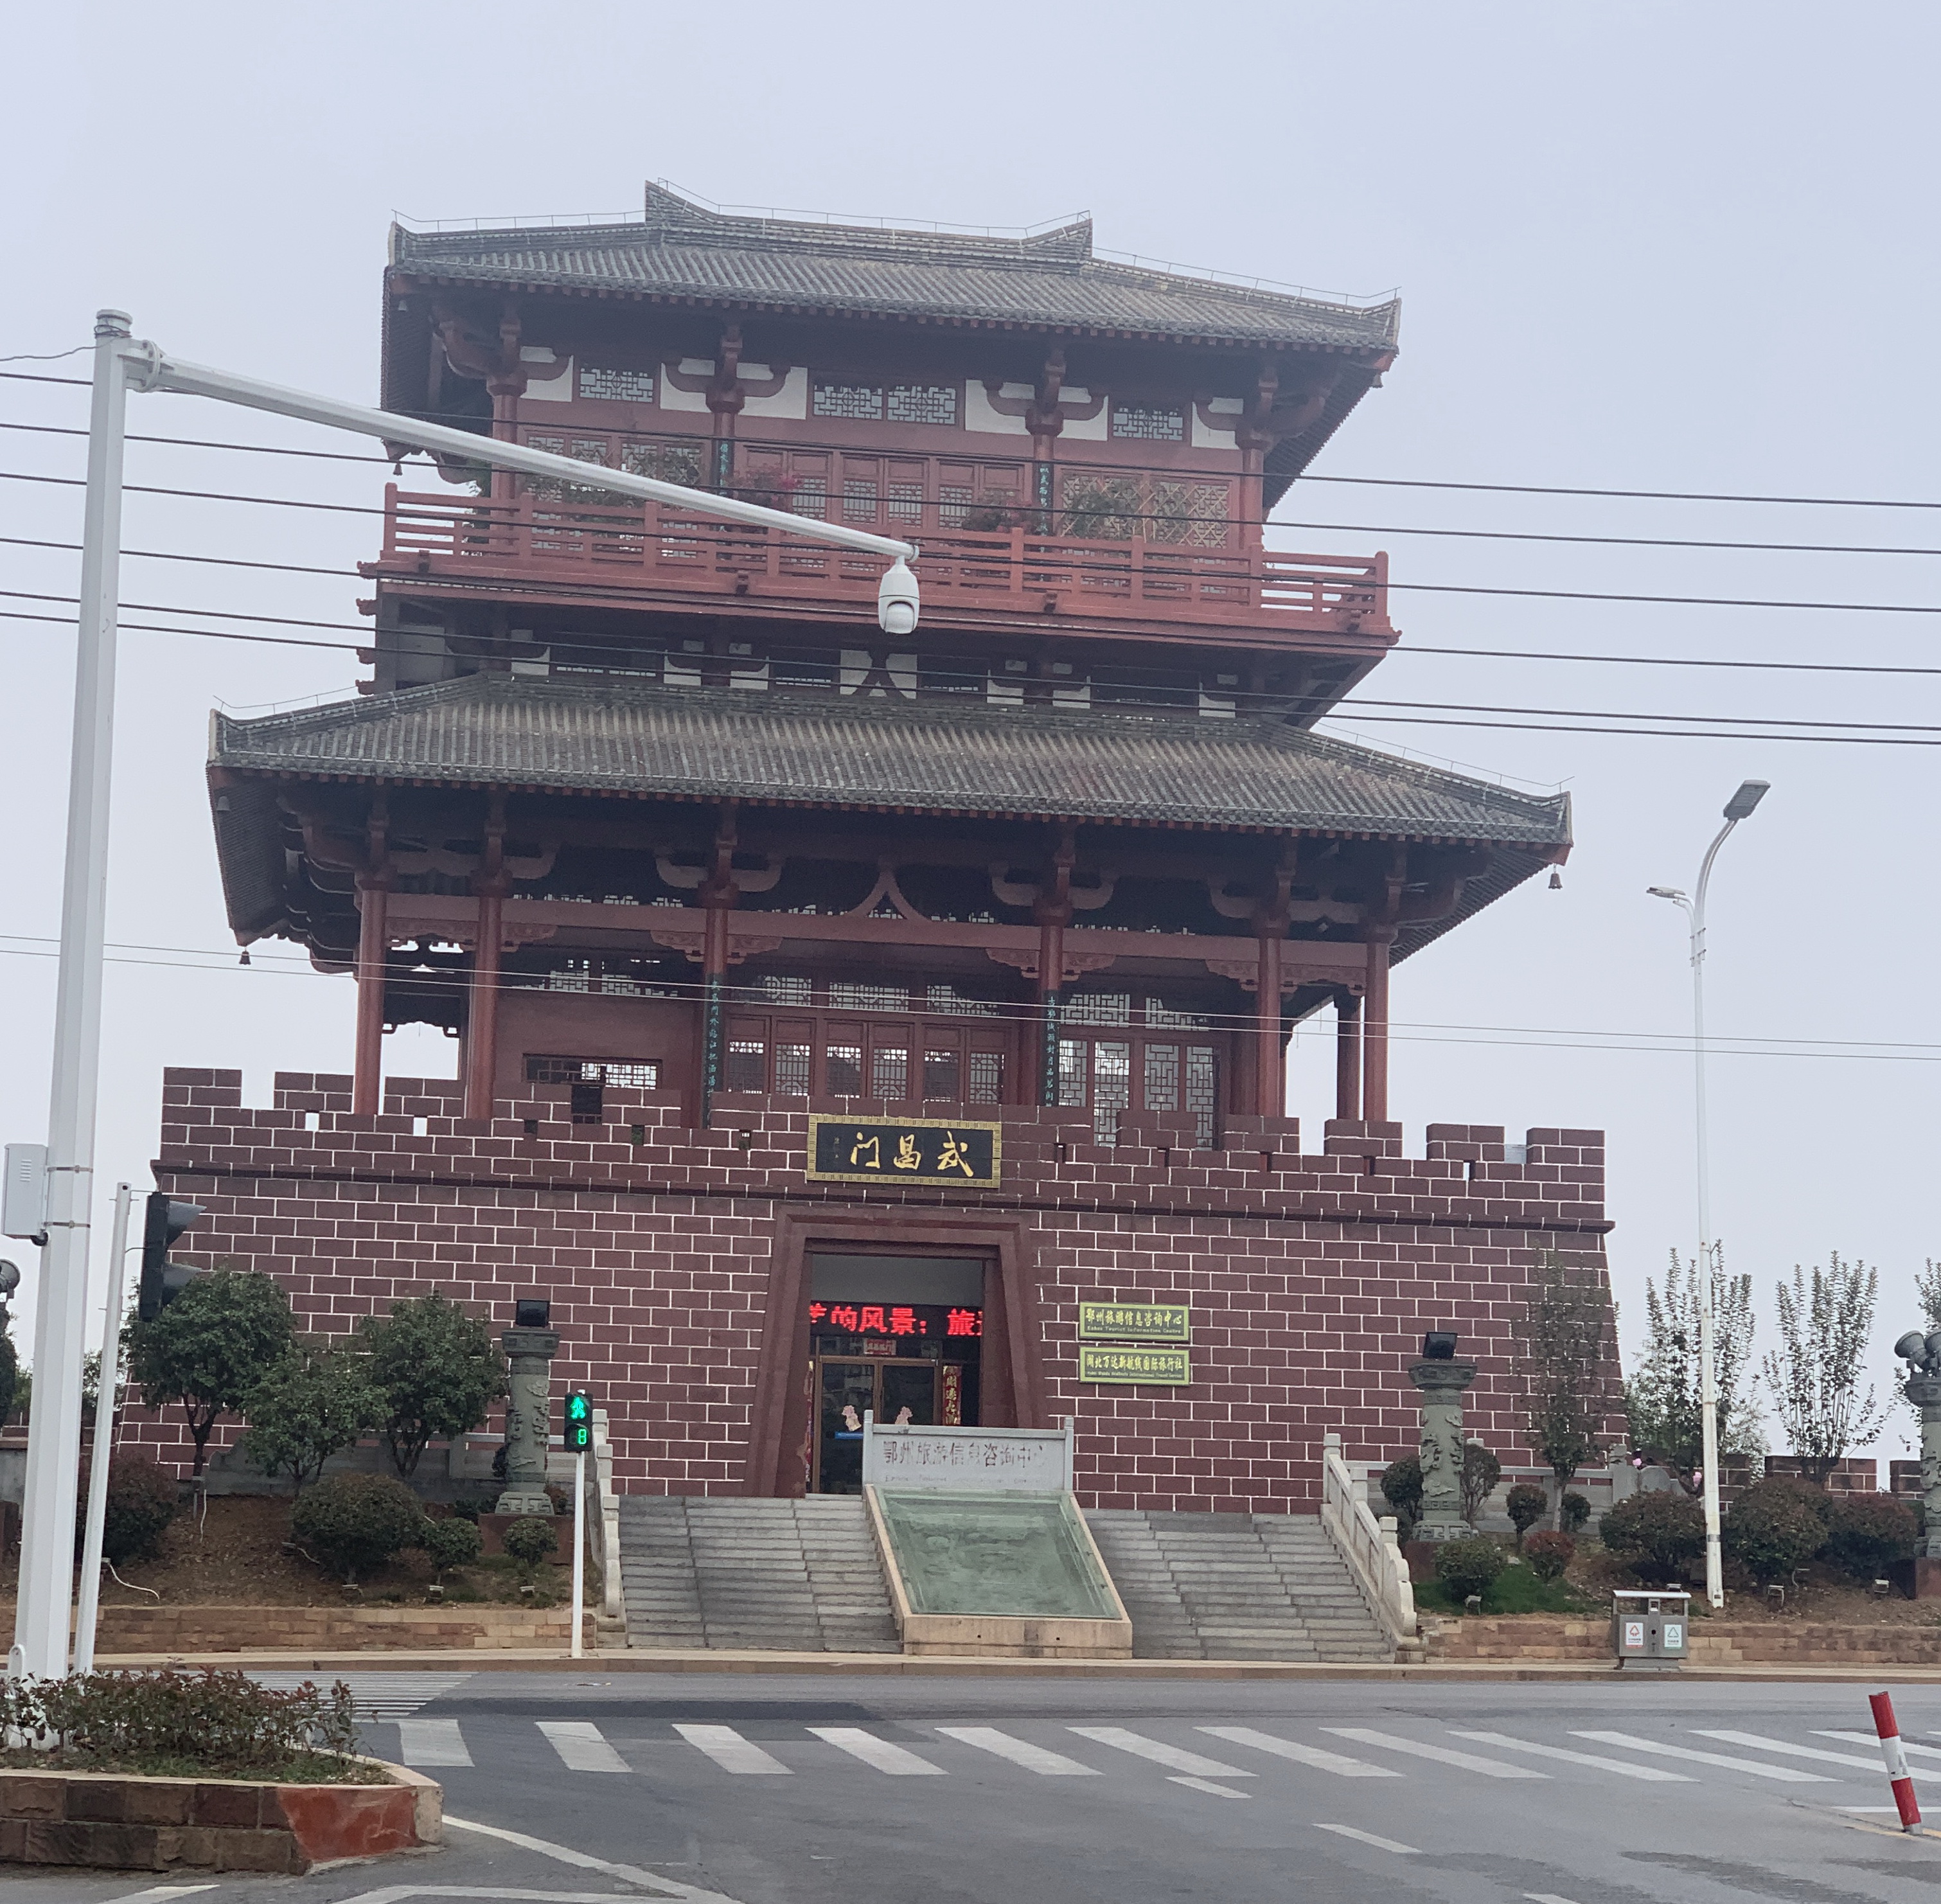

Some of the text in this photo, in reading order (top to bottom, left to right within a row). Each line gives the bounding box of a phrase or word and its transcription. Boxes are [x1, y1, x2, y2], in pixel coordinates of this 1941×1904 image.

[850, 1130, 973, 1177] 武昌门
[1086, 1308, 1182, 1327] 鄂州旅游信息咨询中心
[578, 1429, 587, 1445] 8
